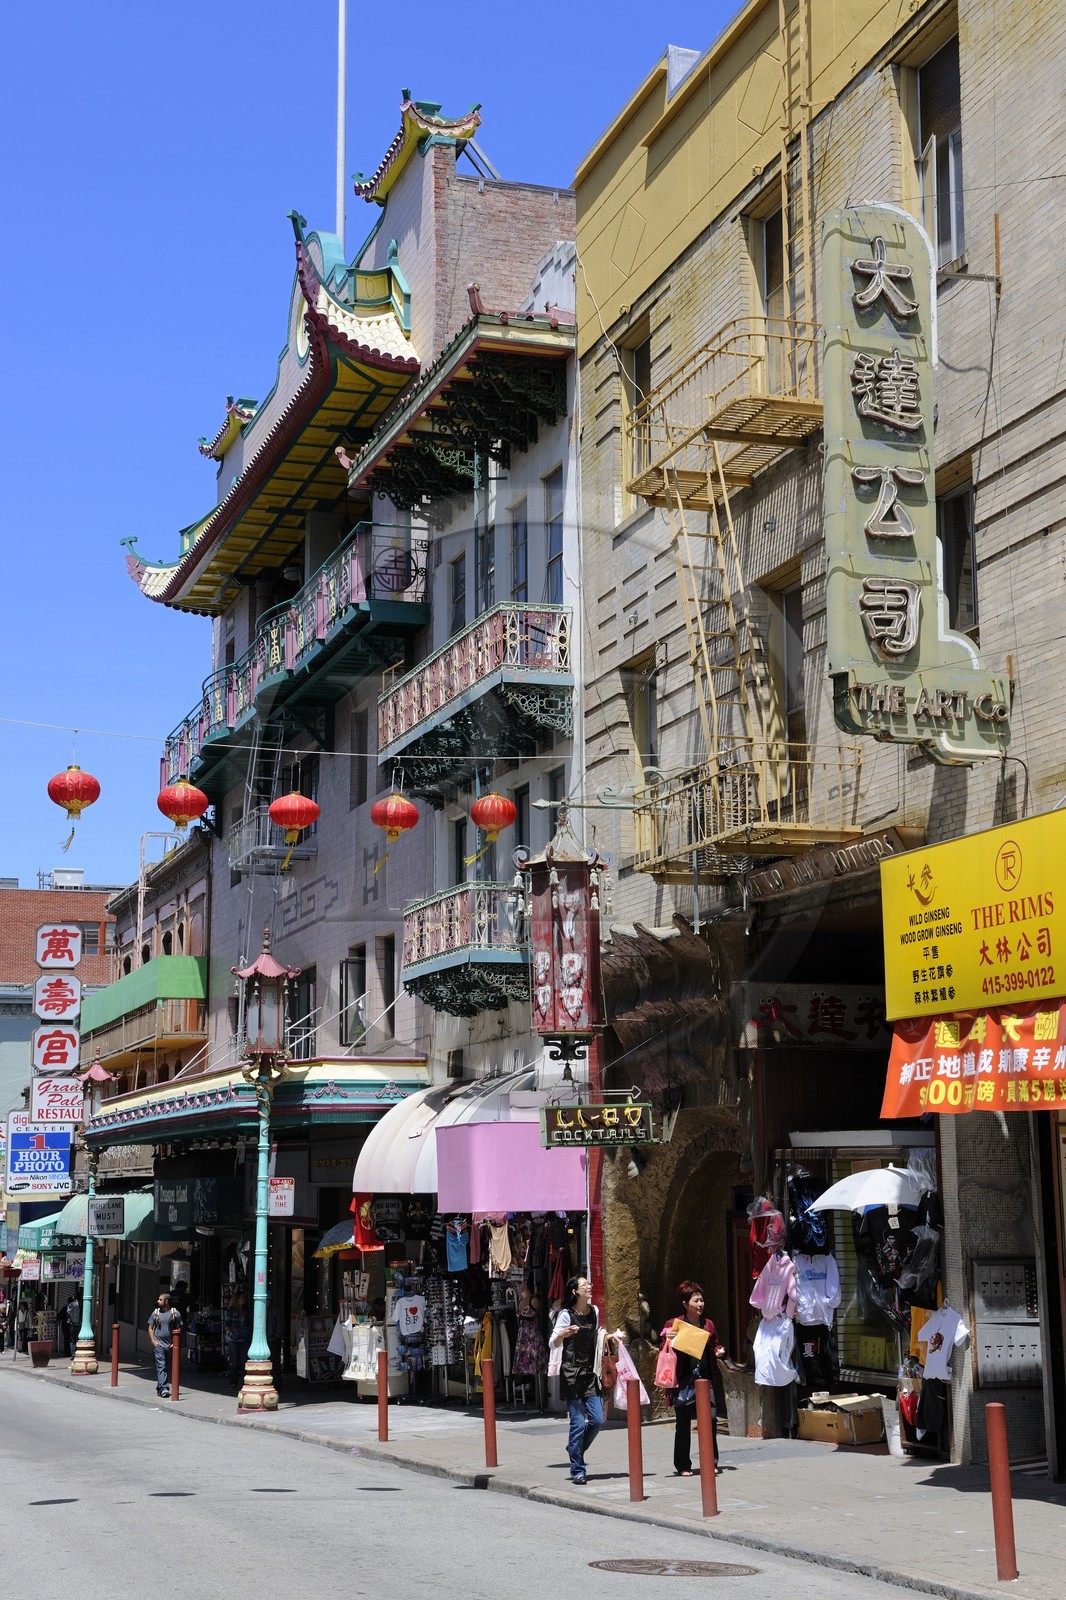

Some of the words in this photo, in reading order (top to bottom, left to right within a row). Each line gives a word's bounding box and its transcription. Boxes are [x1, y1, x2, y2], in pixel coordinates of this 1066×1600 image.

[853, 684, 907, 717] THE
[913, 688, 969, 721] ART
[908, 912, 923, 927] WILD
[924, 907, 950, 924] GINSENG
[970, 902, 1005, 931] THE
[1007, 891, 1054, 923] RIMS
[900, 931, 917, 945] WOOD
[917, 927, 934, 942] GROW
[935, 922, 963, 937] GINSENG
[979, 927, 1052, 967] 大林公司
[982, 966, 1056, 995] 415-399-0122
[38, 928, 80, 1066] 萬壽宮
[29, 1133, 50, 1150] 1
[552, 1128, 647, 1141] COCKTAILS
[14, 1161, 65, 1172] PHOTO
[18, 1150, 61, 1161] HOUR
